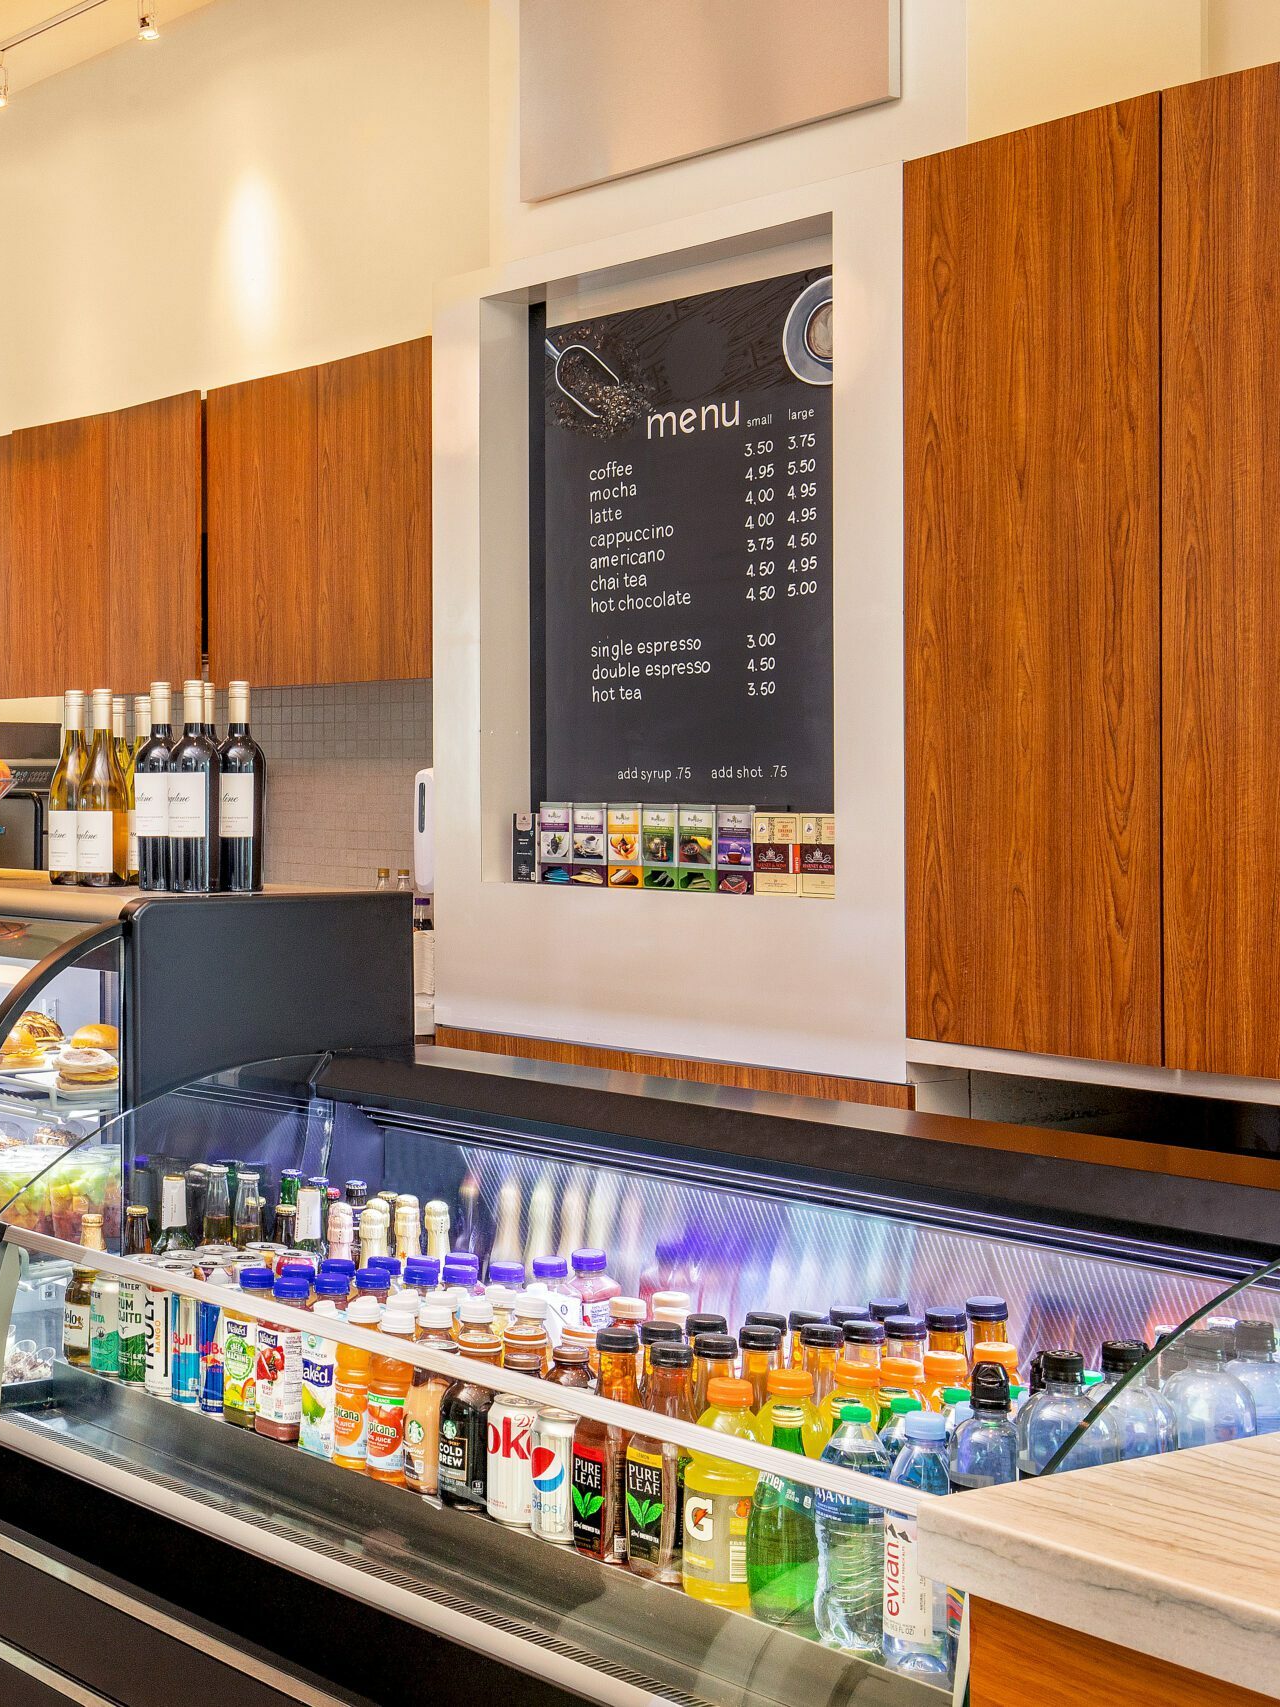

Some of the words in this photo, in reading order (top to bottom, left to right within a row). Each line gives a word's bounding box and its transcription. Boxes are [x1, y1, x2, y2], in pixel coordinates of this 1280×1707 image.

[647, 400, 740, 440] menu
[746, 414, 772, 428] small
[788, 408, 815, 421] large
[589, 461, 633, 481] coffee
[744, 441, 774, 457] 3.50
[787, 433, 816, 450] 3.75
[589, 482, 637, 502] mocha
[744, 464, 775, 482] 4.95
[787, 459, 816, 475] 5.50
[589, 507, 623, 525] latte
[745, 488, 775, 506] 4.00
[787, 483, 817, 499] 4.95
[589, 525, 674, 549] cappuccino
[745, 512, 775, 529] 4.00
[787, 507, 817, 523] 4.95
[589, 549, 665, 570] americano
[746, 537, 775, 553] 3.75
[787, 532, 817, 549] 4.50
[590, 573, 619, 592] chai
[623, 573, 648, 588] tea
[746, 561, 775, 577] 4.50
[787, 556, 818, 573] 4.95
[590, 596, 616, 613] hot
[617, 590, 692, 612] chocolate
[745, 586, 776, 602] 4.50
[787, 581, 818, 597] 5.00
[590, 640, 633, 661] single
[637, 638, 702, 657] espresso
[746, 633, 776, 649] 3.00
[591, 662, 640, 680] double
[645, 660, 711, 678] espresso
[747, 657, 776, 673] 4.50
[592, 686, 616, 702] hot
[619, 686, 642, 701] tea
[747, 681, 776, 696] 3.50
[617, 767, 638, 780] add
[640, 770, 672, 784] syrup
[675, 767, 692, 780] .75
[711, 766, 733, 779] add
[736, 766, 763, 779] shot
[770, 765, 788, 778] .75
[303, 1366, 330, 1384] aked.
[439, 1443, 463, 1457] COLD
[439, 1453, 463, 1467] BREW
[575, 1457, 601, 1477] PURE
[628, 1463, 660, 1484] PURE
[685, 1496, 714, 1541] G
[886, 1541, 900, 1617] evian
